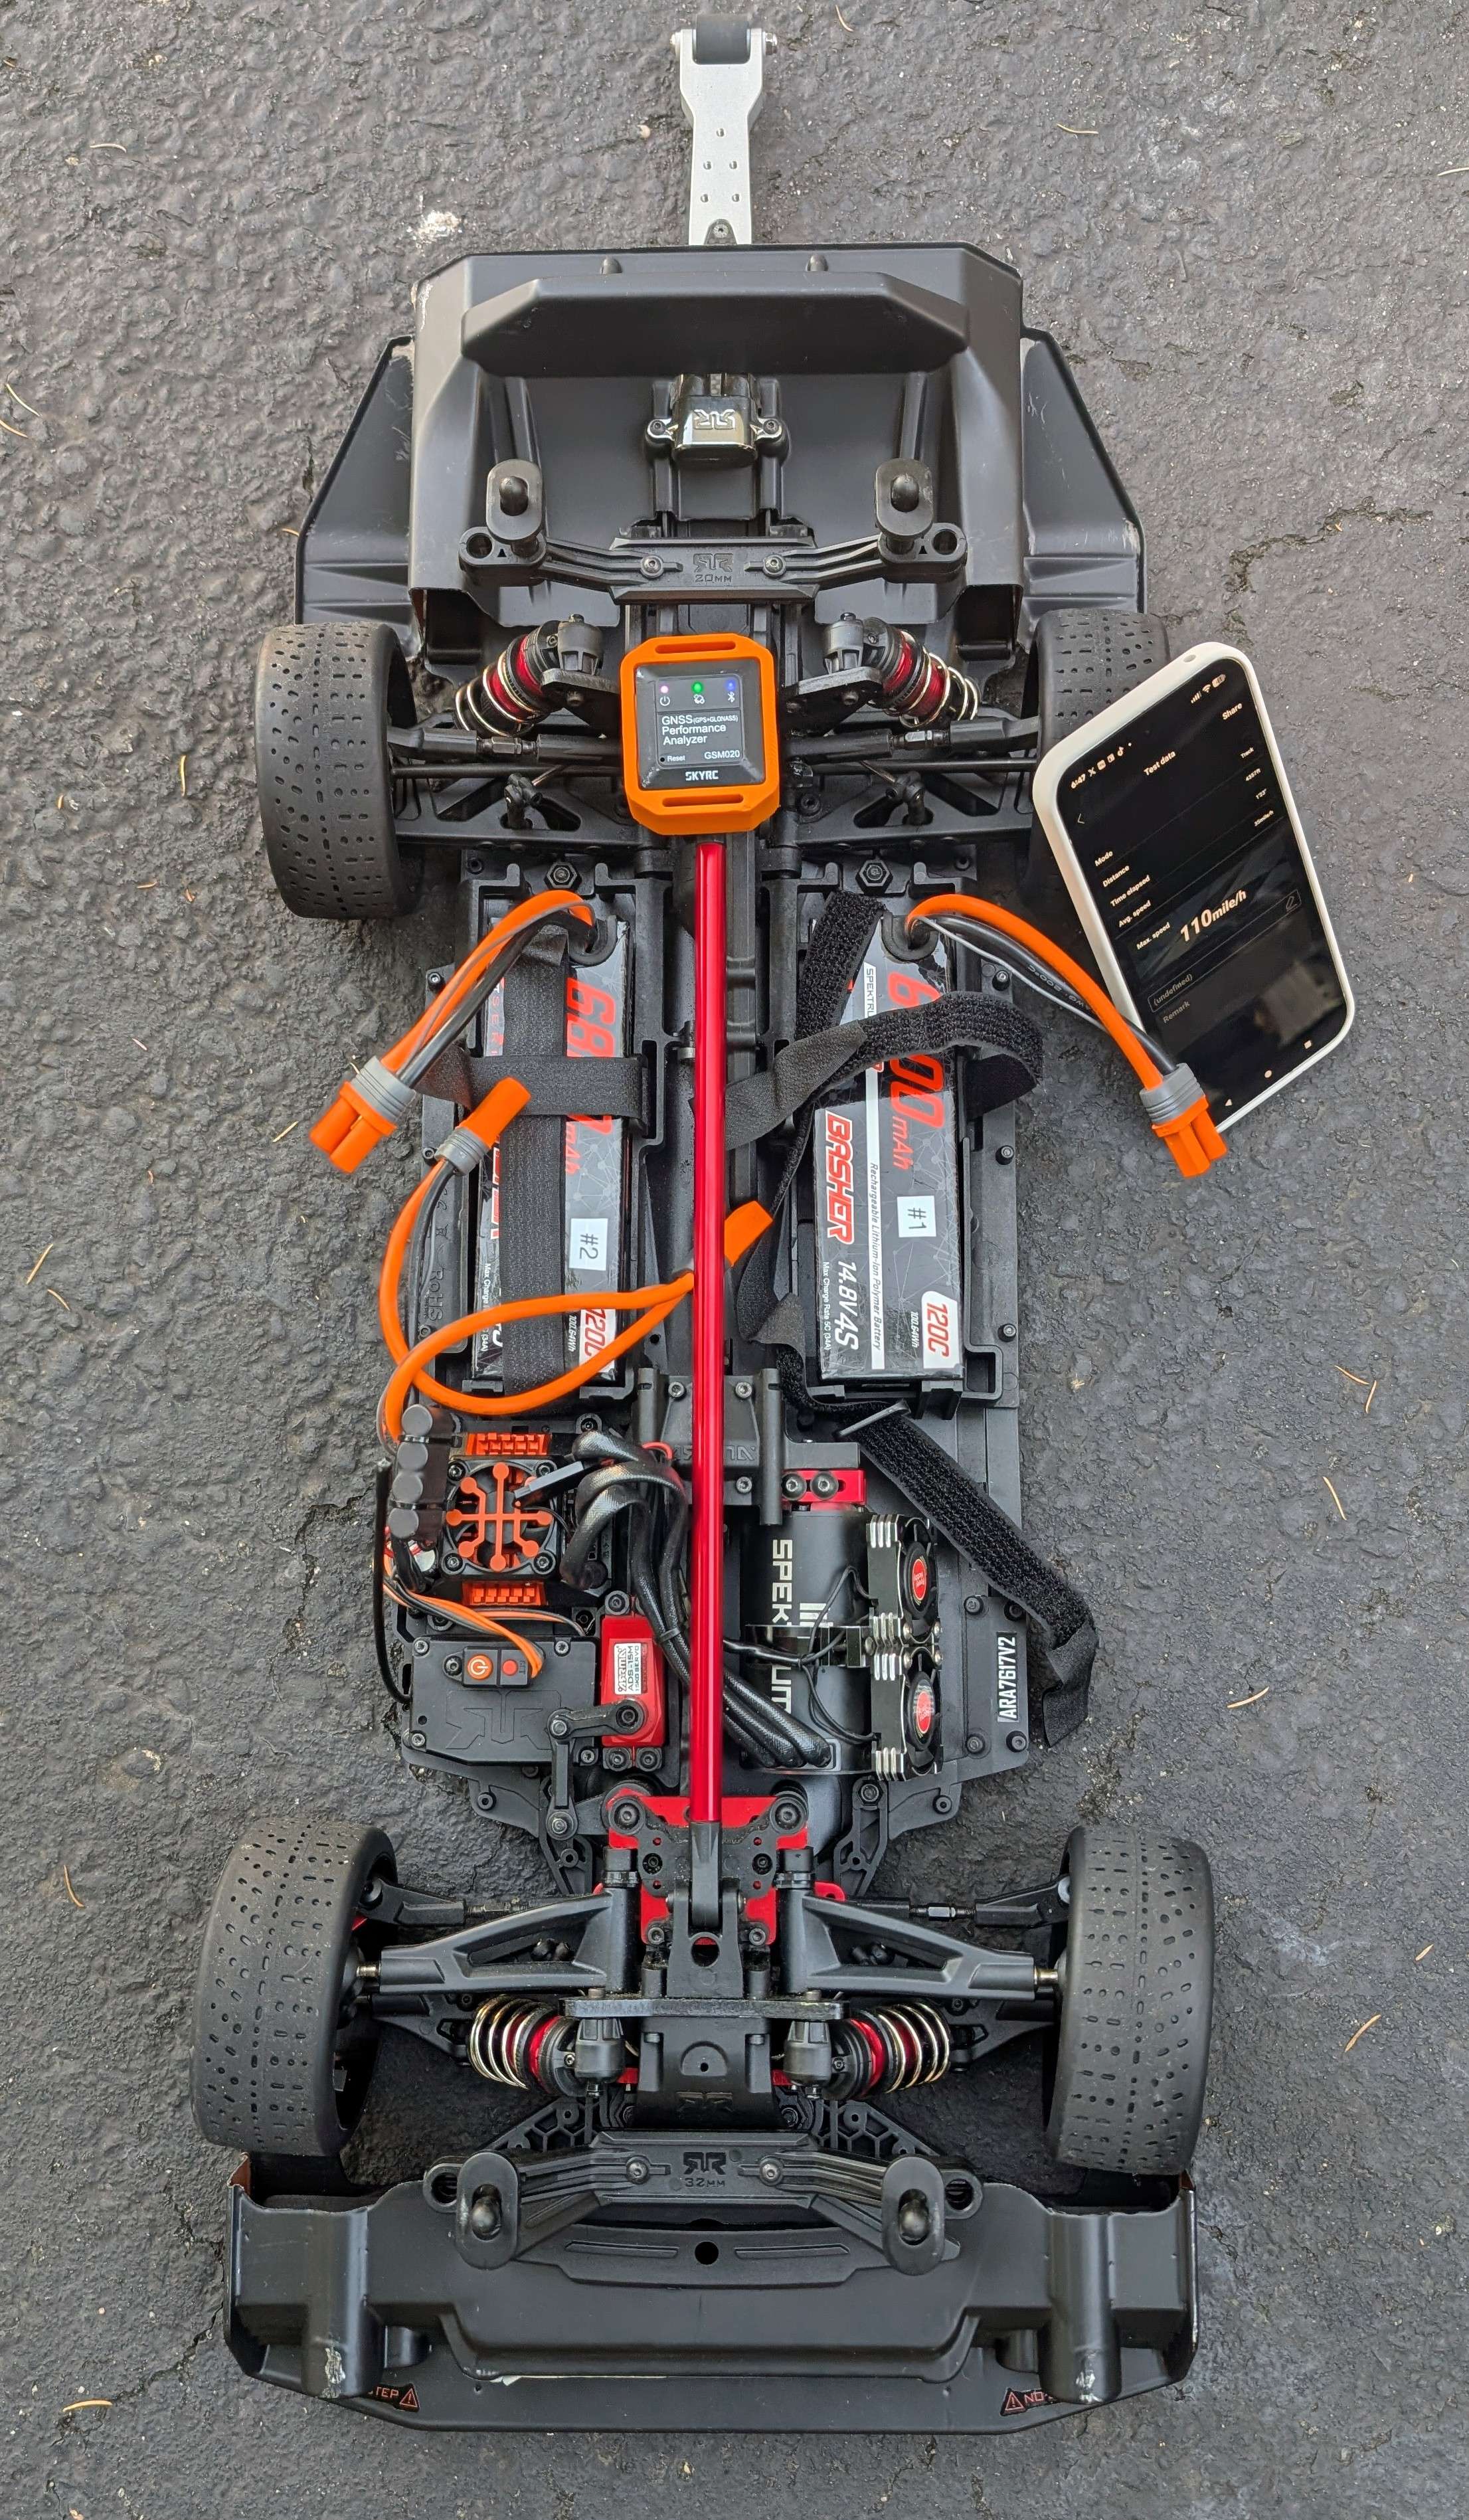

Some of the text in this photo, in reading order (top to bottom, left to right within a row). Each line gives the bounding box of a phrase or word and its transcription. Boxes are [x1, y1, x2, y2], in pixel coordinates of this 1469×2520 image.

[661, 715, 693, 725] GNSS
[1222, 703, 1243, 720] Share
[661, 724, 727, 735] Performance
[663, 735, 708, 746] Analyzer
[704, 749, 740, 759] GSM020
[1144, 751, 1176, 776] Test data
[1241, 747, 1254, 759] Track
[685, 770, 719, 781] SKYRC
[1071, 773, 1086, 789] 6:47
[1094, 851, 1113, 867] Mode
[1102, 865, 1130, 887] Distance
[1110, 874, 1151, 907] Time elapsed
[1118, 899, 1152, 928] Avg. speed
[1136, 921, 1171, 950] Max. speed
[1153, 974, 1193, 1006] (undefined)
[1163, 1000, 1190, 1023] Remark
[825, 1109, 855, 1245] BASHER
[907, 1207, 927, 1229] #1
[579, 1233, 599, 1259] #2
[870, 1162, 882, 1350] Rechargeable Lithium-Ion Polymer Battery
[429, 1267, 444, 1321] RoHS
[482, 1279, 491, 1304] Charge
[568, 1314, 577, 1352] 100.64Wh
[823, 1322, 831, 1332] 5C
[910, 1310, 919, 1348] 100.64Wh
[926, 1302, 950, 1357] 120C
[480, 1333, 489, 1352] (34A)
[997, 1636, 1017, 1719] ARA7617V2
[368, 2386, 399, 2398] TEP
[1023, 2391, 1045, 2404] NO
